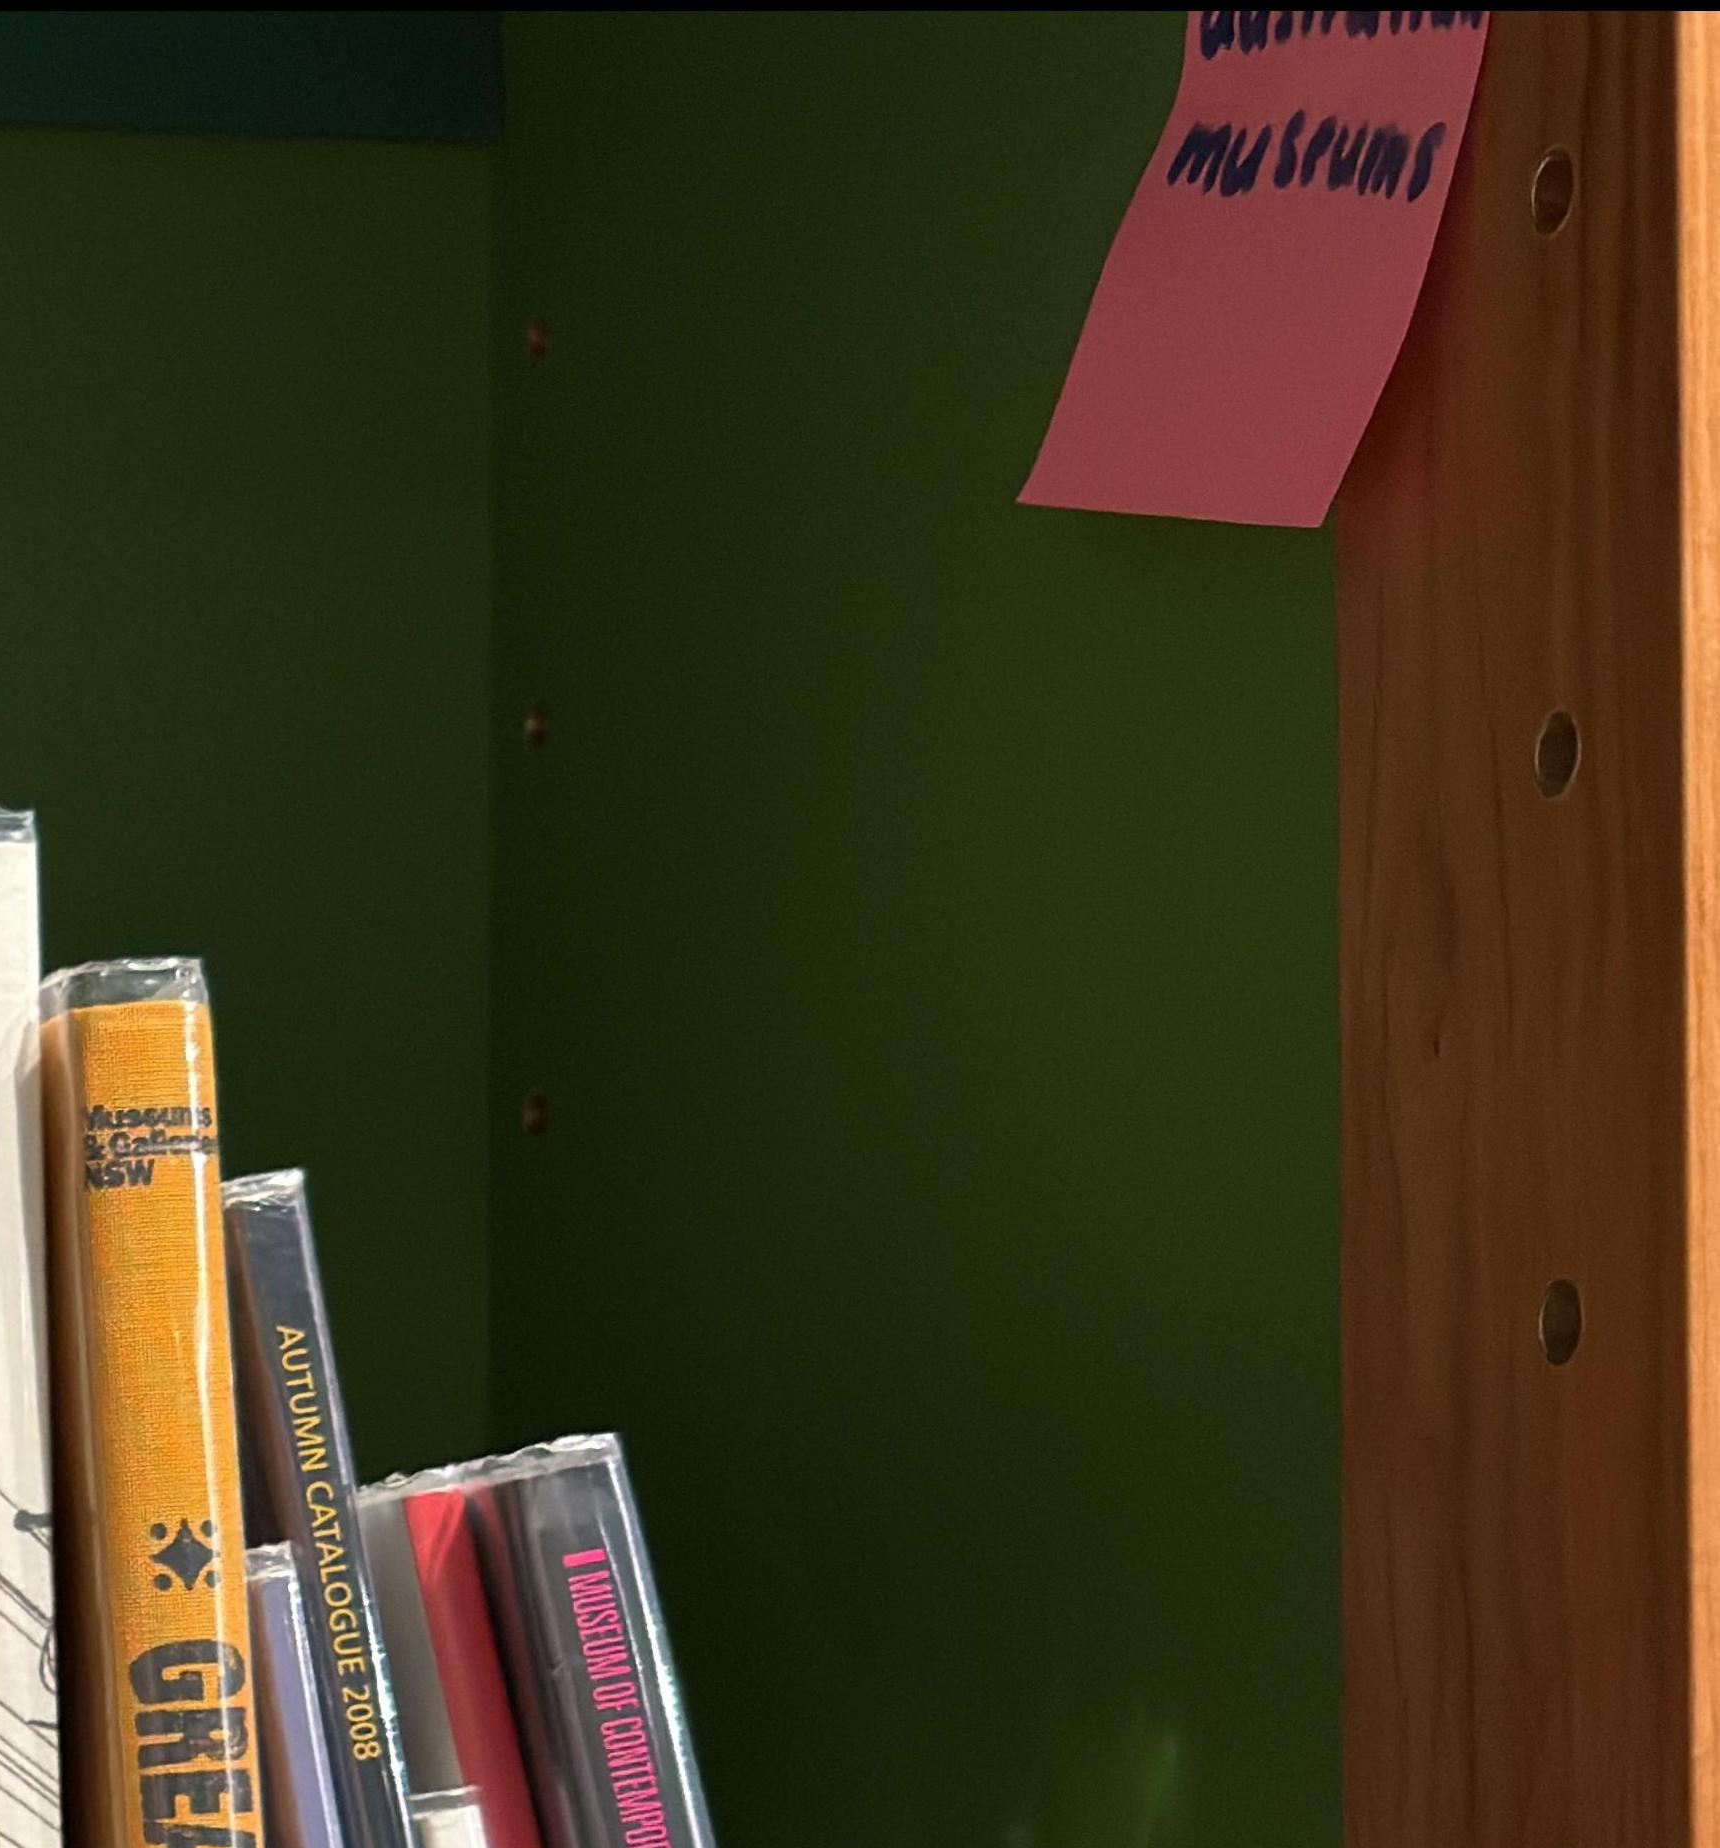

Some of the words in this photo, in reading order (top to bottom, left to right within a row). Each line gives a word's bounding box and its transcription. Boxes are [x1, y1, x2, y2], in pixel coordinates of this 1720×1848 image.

[1167, 108, 1446, 202] museums
[276, 1324, 330, 1473] AUTUMN
[303, 1480, 366, 1677] CATALOGUE
[340, 1686, 381, 1763] 2008
[568, 1570, 634, 1681] MUSEUM
[592, 1682, 640, 1714] OF
